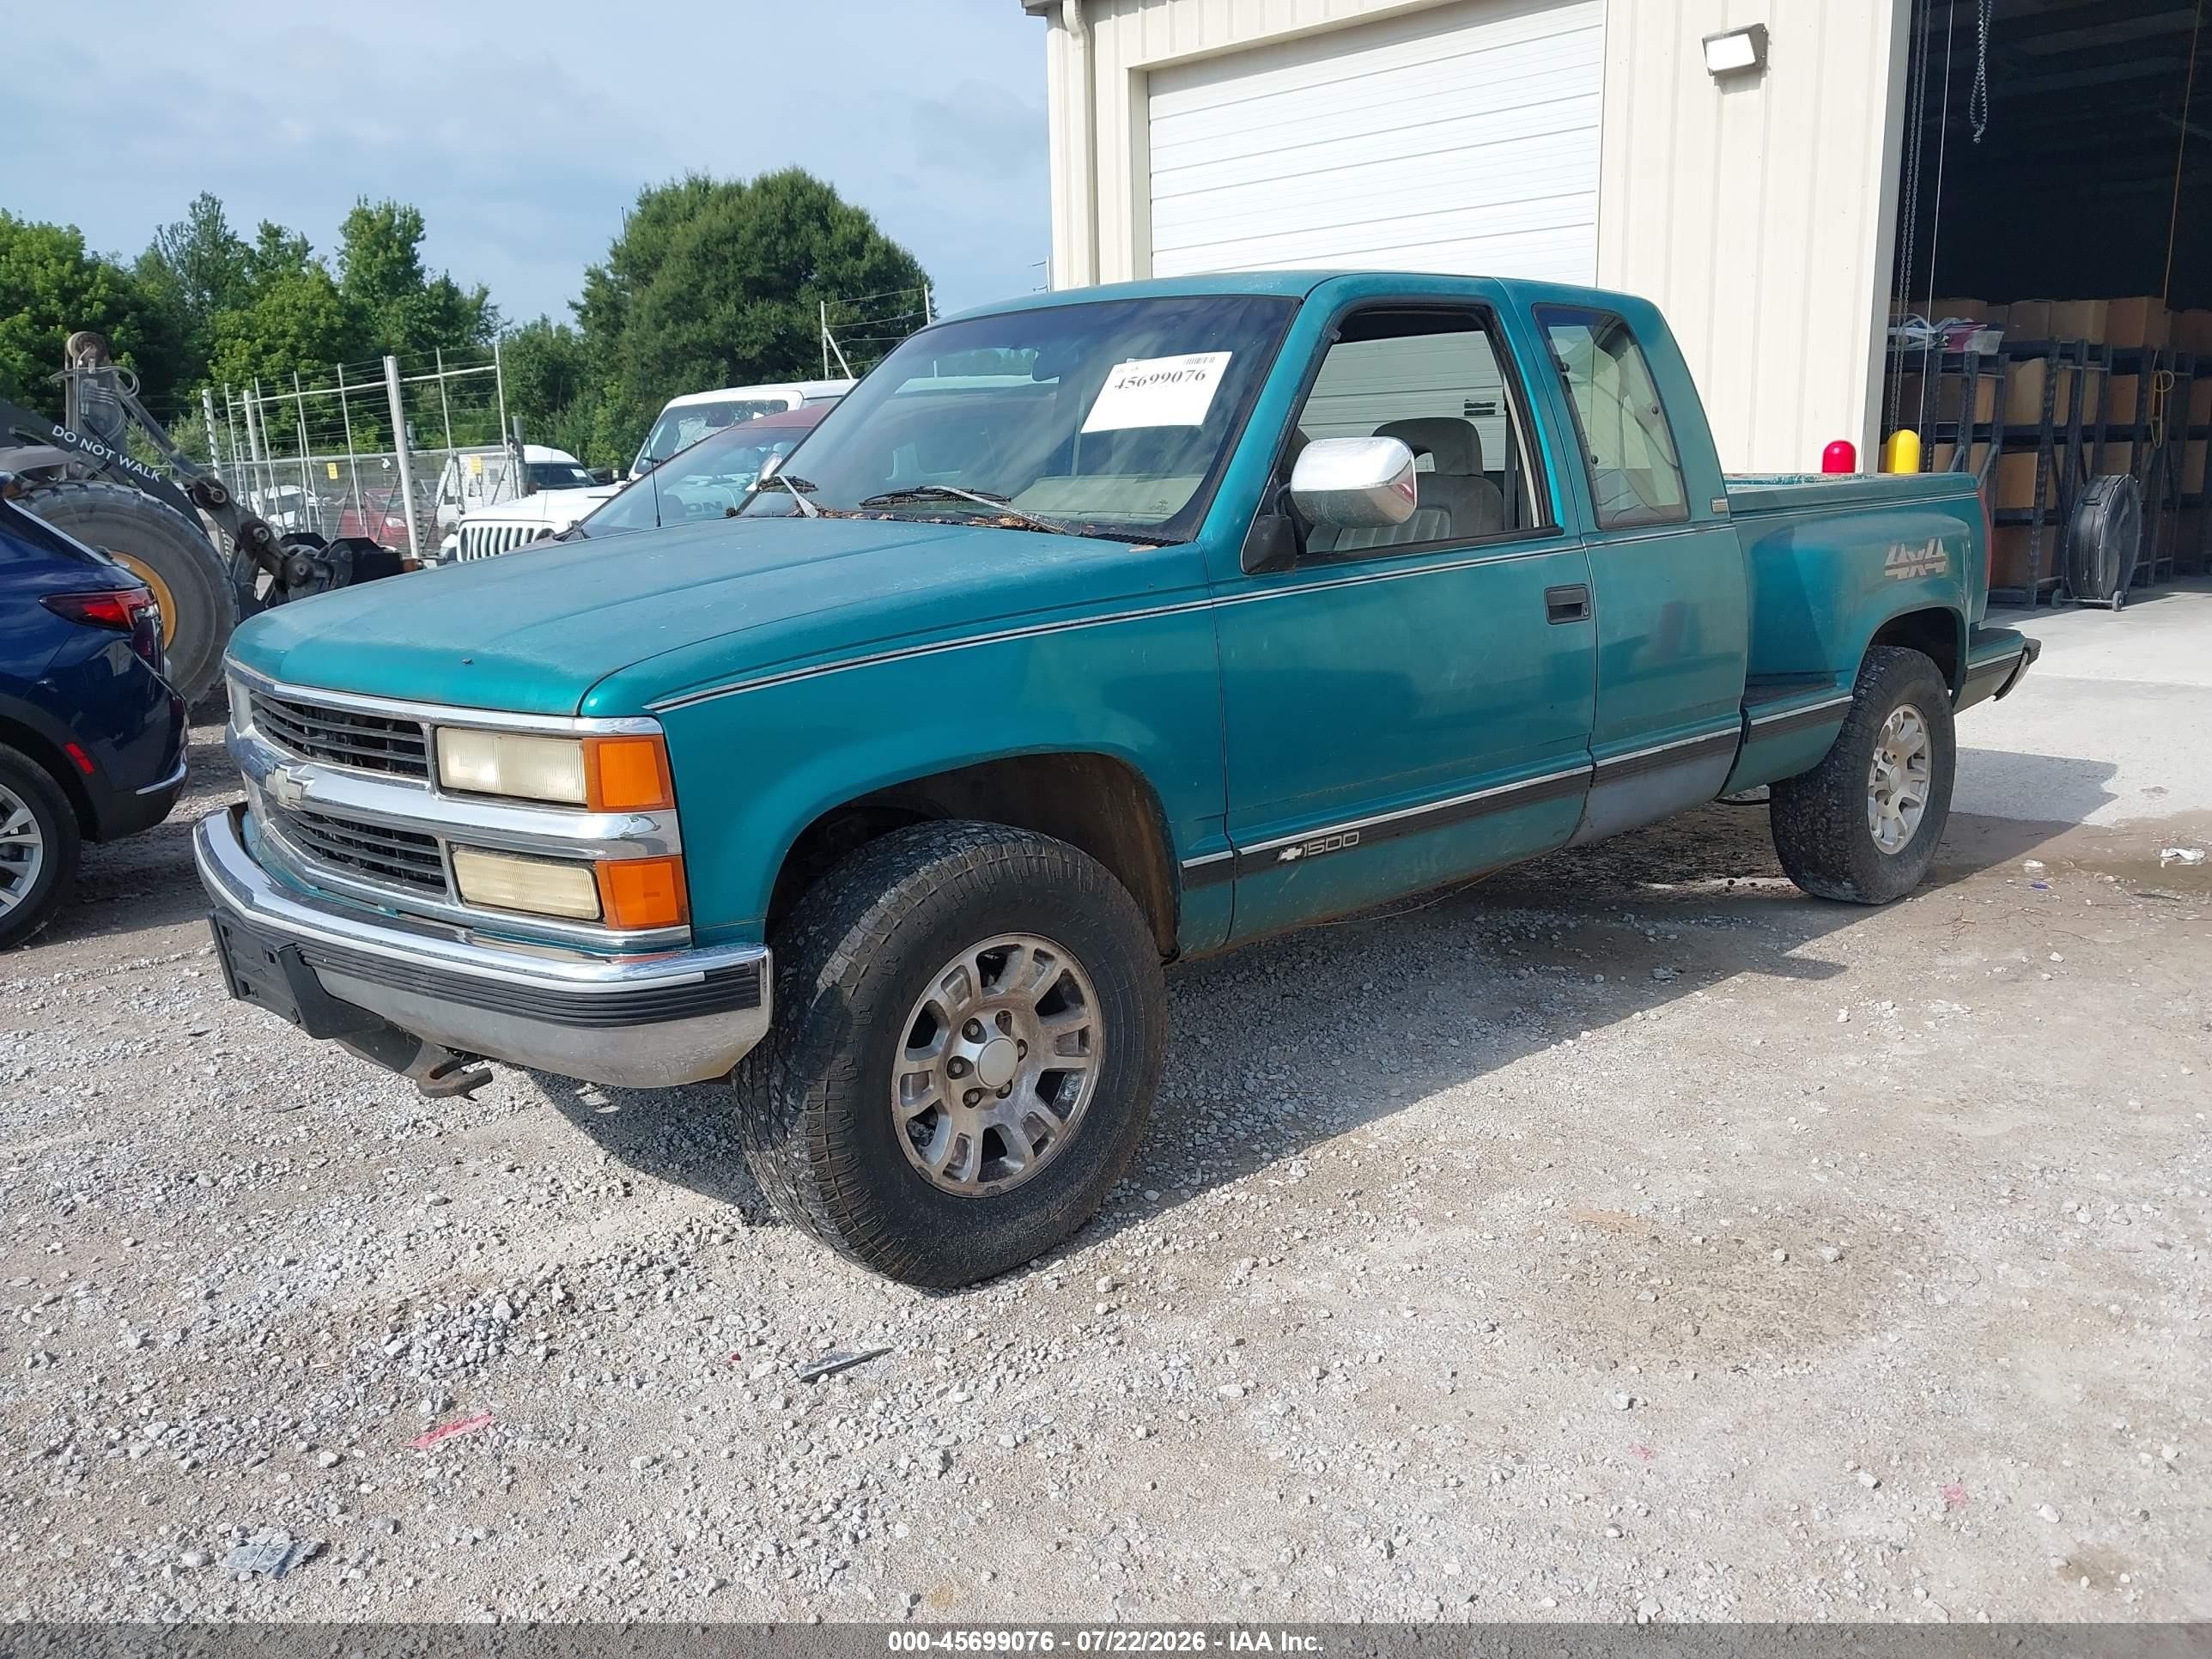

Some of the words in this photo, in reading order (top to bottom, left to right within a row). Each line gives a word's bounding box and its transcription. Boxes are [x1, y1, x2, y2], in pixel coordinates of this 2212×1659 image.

[1115, 368, 1206, 389] 45699076
[52, 424, 77, 443] DO
[79, 437, 116, 460] NOT
[118, 453, 161, 483] WALK
[1304, 830, 1360, 858] 1500
